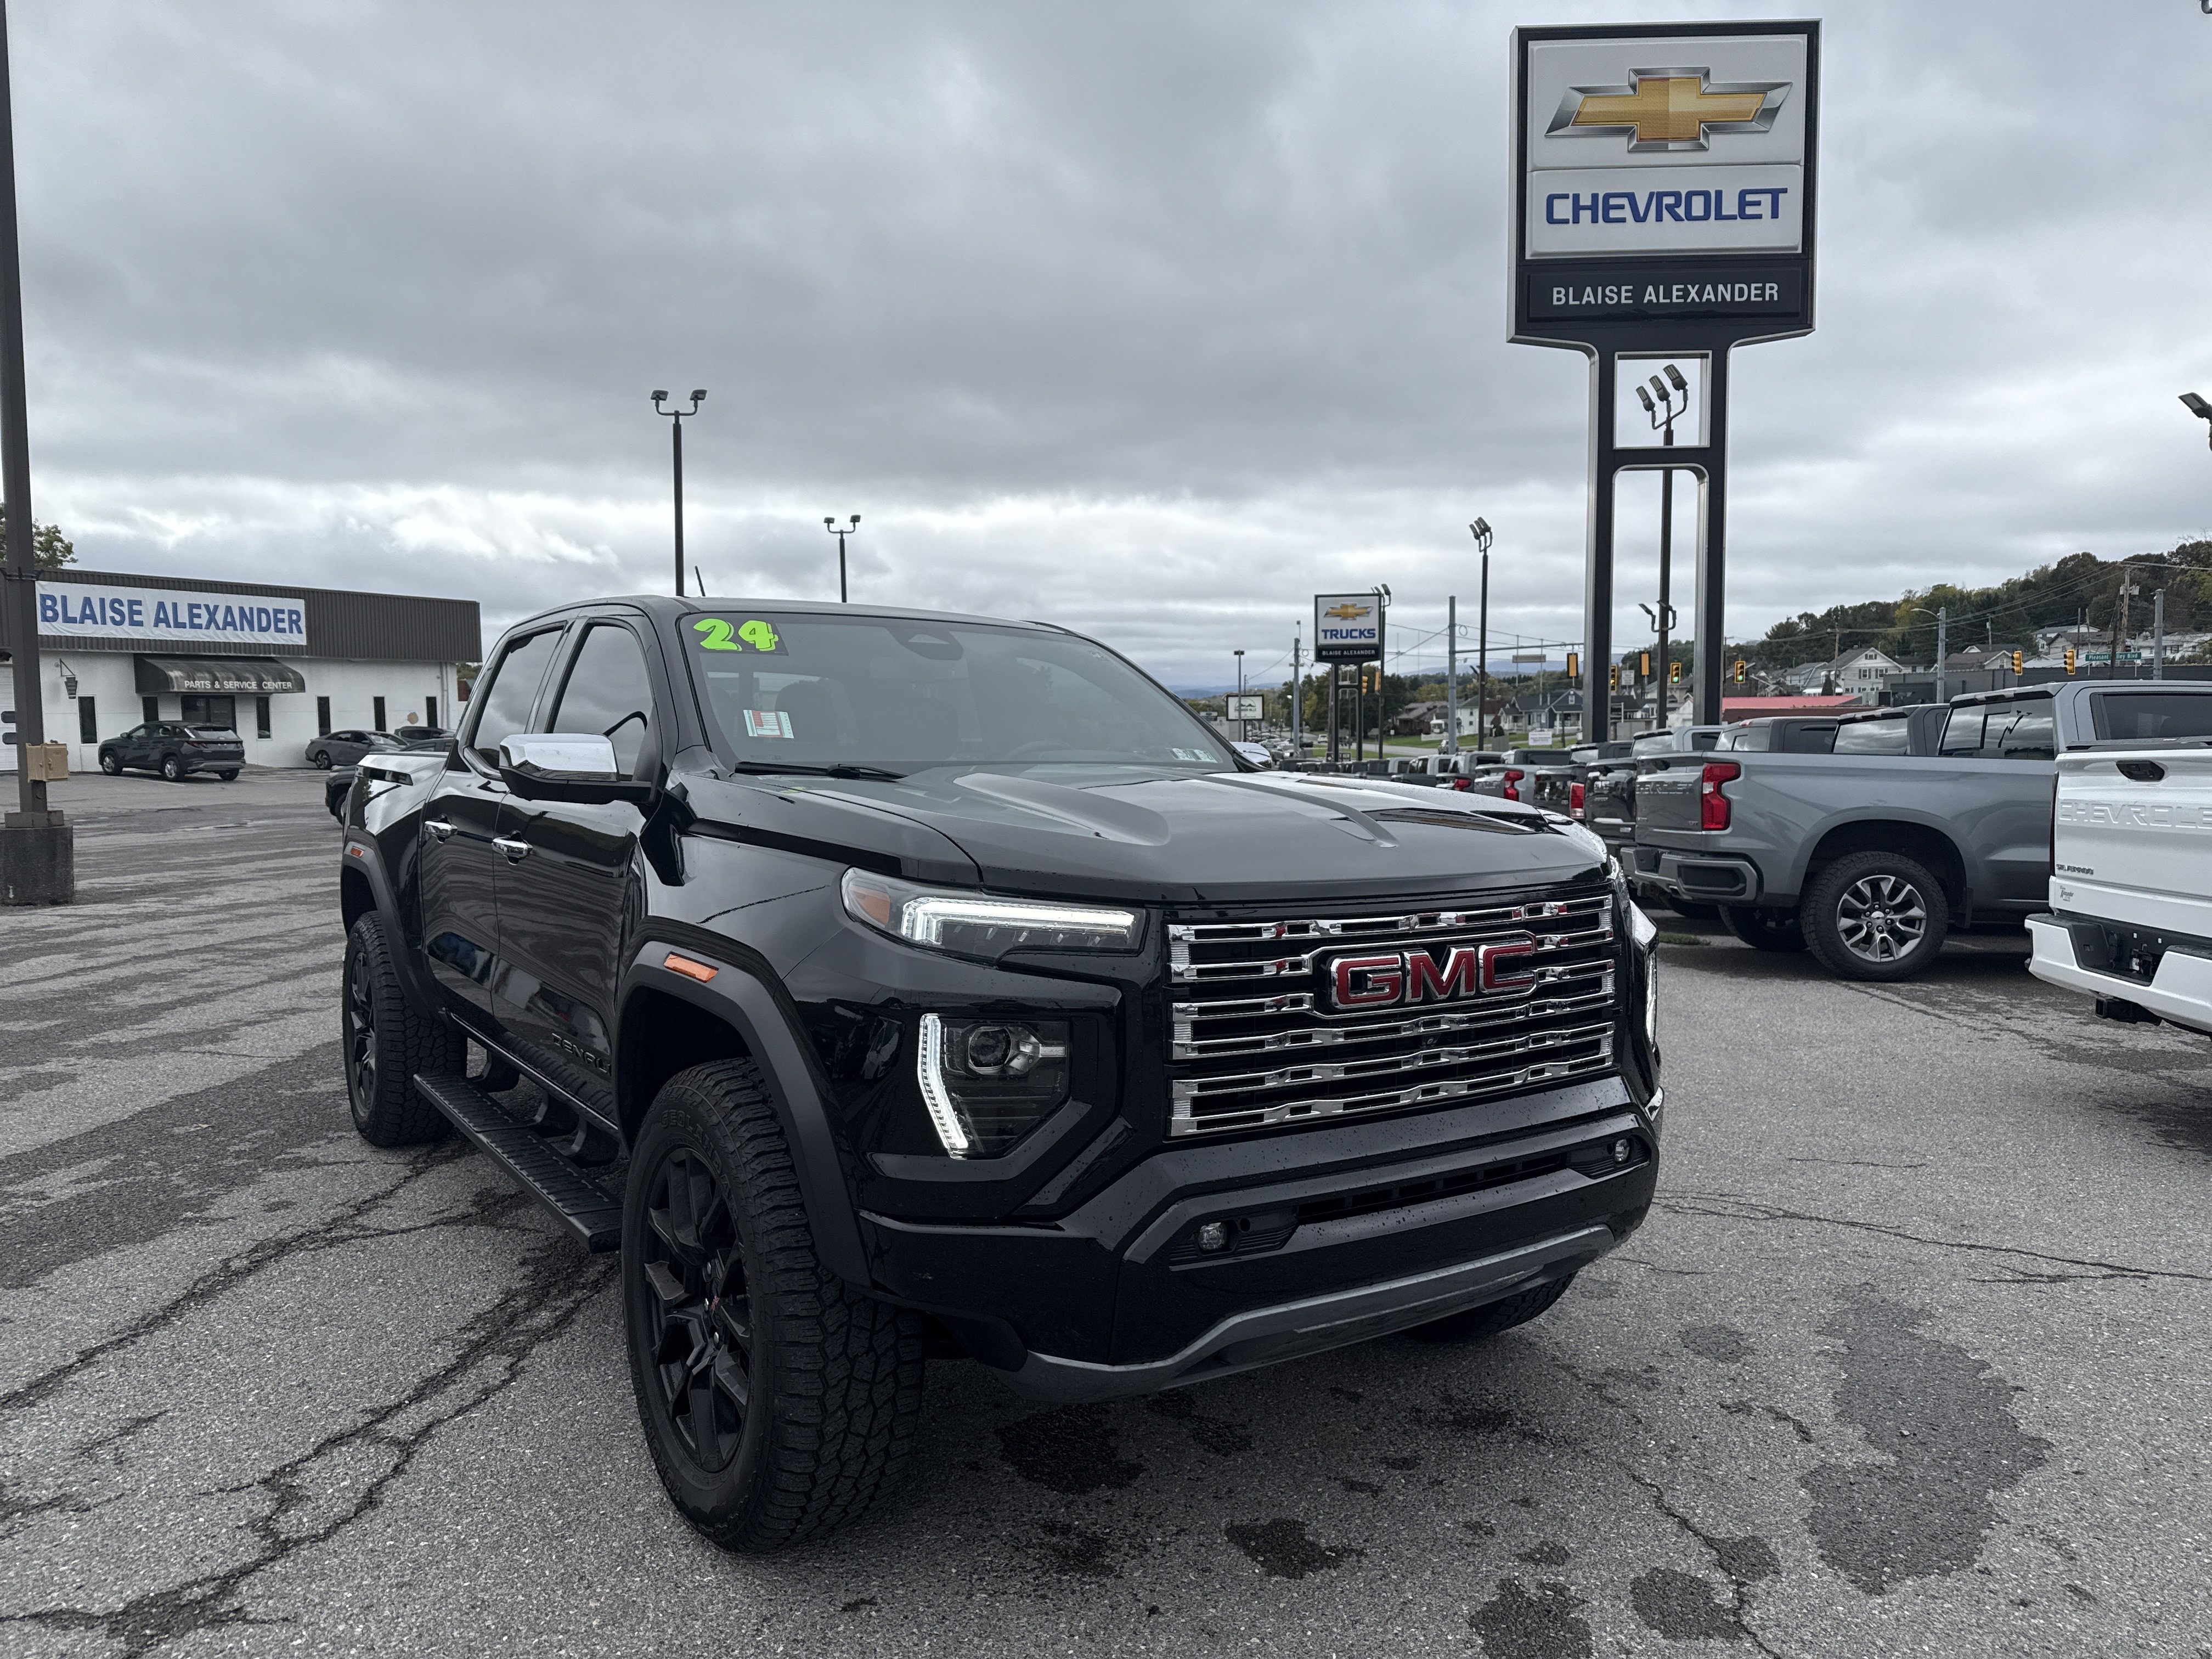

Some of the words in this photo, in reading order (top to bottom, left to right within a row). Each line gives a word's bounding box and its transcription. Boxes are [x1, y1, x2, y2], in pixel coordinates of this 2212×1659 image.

[1546, 188, 1787, 224] CHEVROLET
[1553, 285, 1633, 305] BLAISE
[1643, 283, 1779, 303] ALEXANDER
[39, 593, 144, 627] BLAISE
[153, 601, 303, 634] ALEXANDER
[693, 618, 779, 652] 24
[1321, 628, 1376, 639] TRUCKS
[184, 680, 211, 689] PARTS
[215, 681, 219, 689] &
[223, 681, 257, 689] SERVICE
[262, 681, 292, 689] CENTER
[1330, 940, 1535, 1009] GMC
[551, 1032, 612, 1076] DENALI
